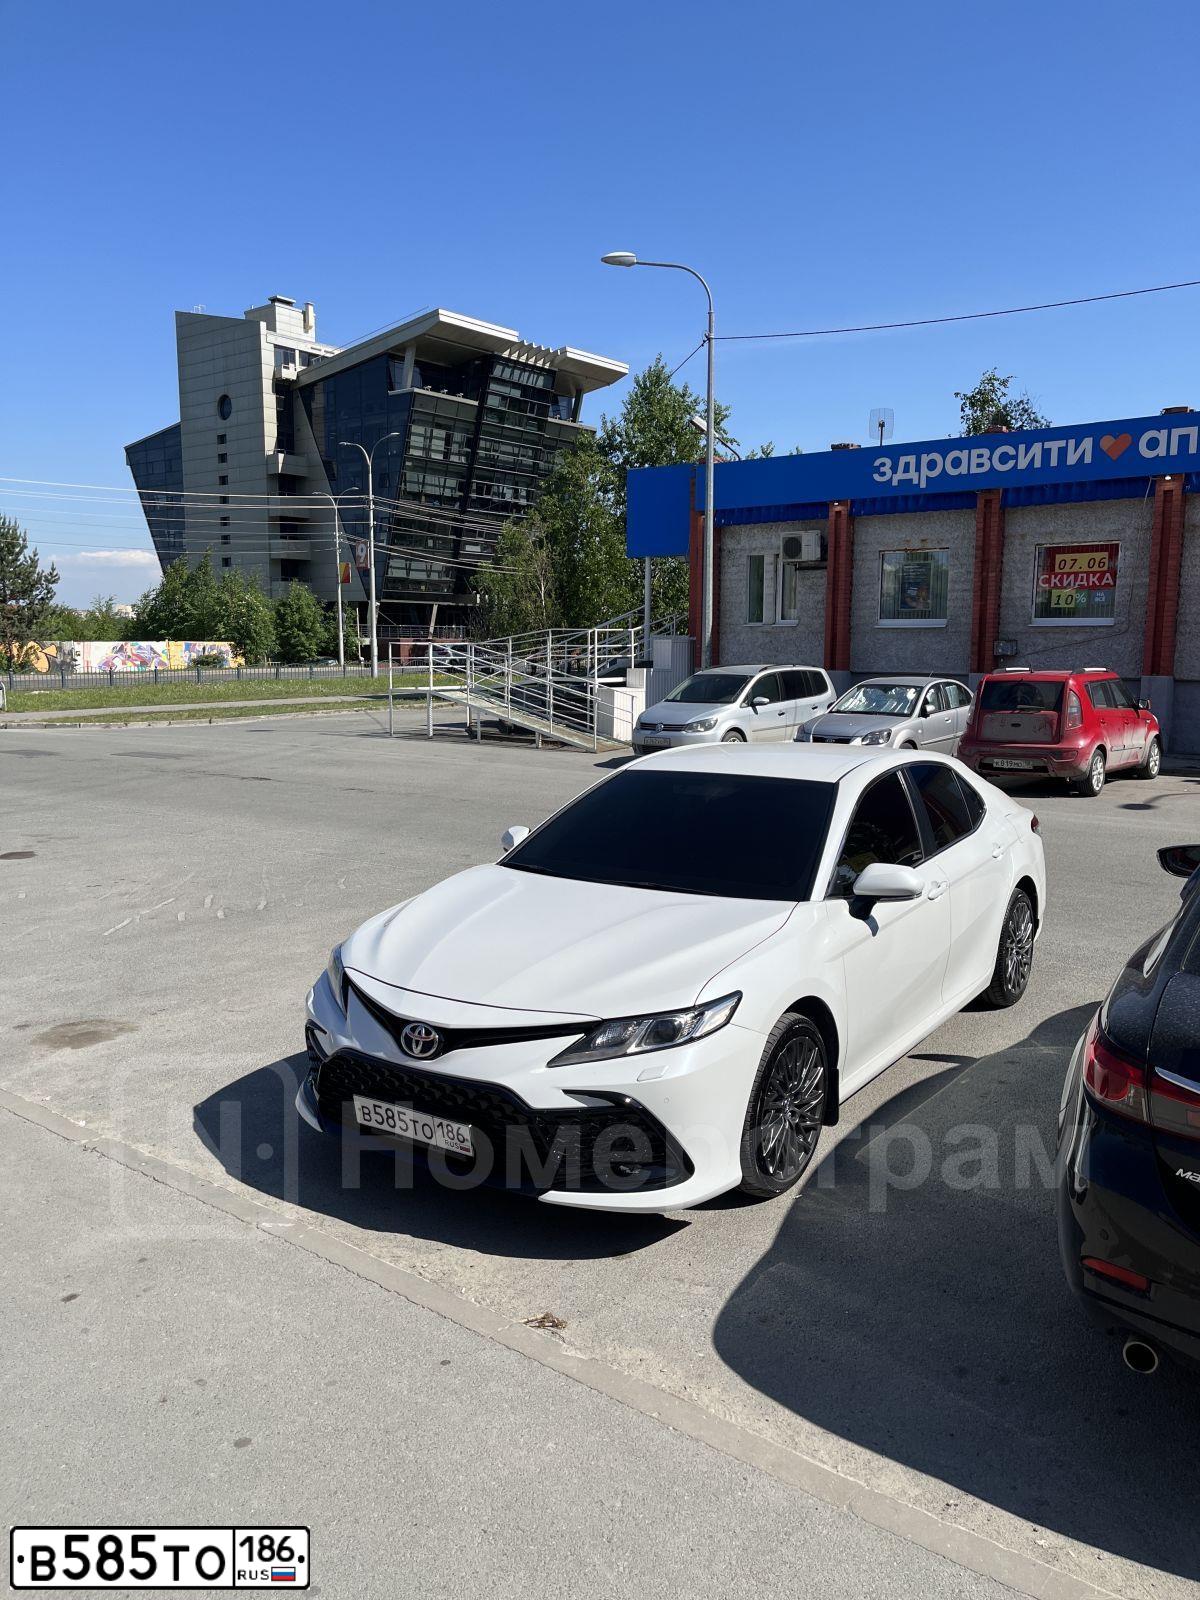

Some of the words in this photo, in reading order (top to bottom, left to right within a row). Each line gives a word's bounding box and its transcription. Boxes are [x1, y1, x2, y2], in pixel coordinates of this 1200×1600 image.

[872, 437, 1093, 488] здравсити
[1058, 556, 1107, 571] 07.06
[1039, 572, 1115, 588] СКИДКА
[361, 1103, 434, 1140] В585ТО
[437, 1121, 466, 1143] 186
[445, 1139, 460, 1150] RUS
